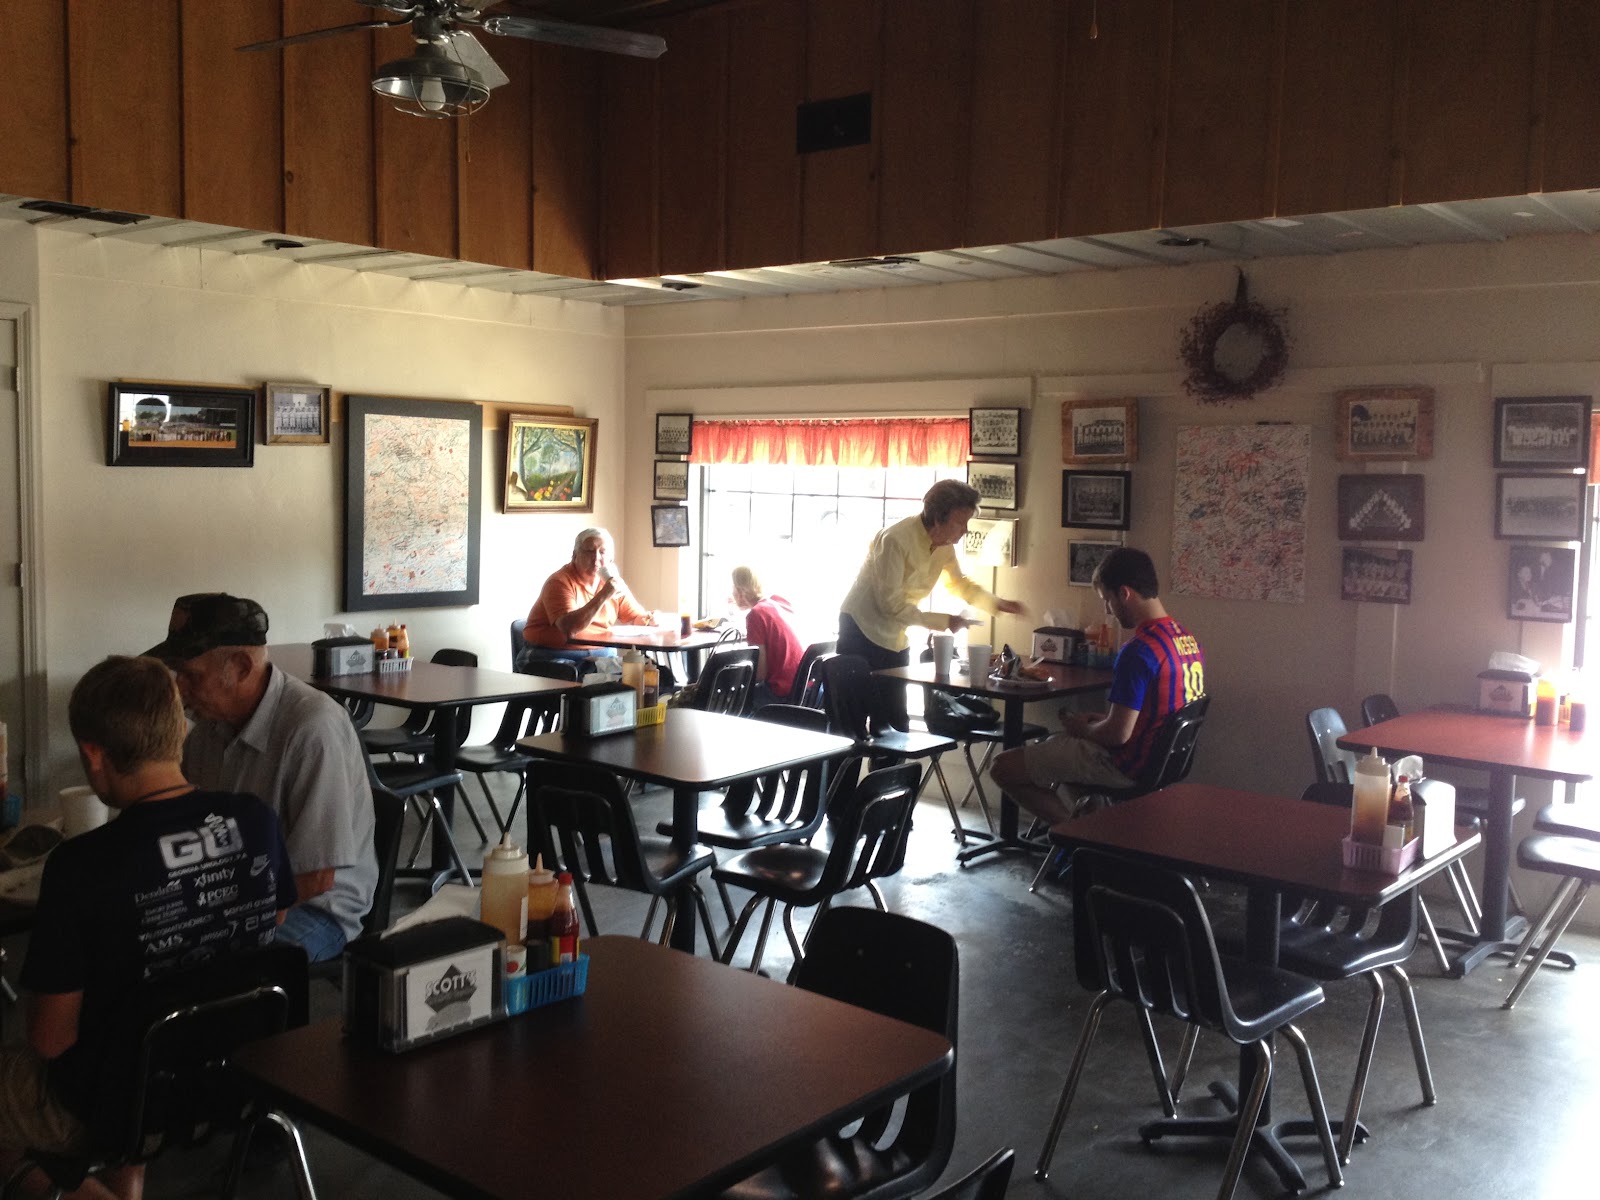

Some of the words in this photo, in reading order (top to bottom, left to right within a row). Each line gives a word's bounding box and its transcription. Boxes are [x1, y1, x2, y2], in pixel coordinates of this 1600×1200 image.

[1182, 661, 1204, 703] 10
[145, 933, 183, 952] AMS
[425, 970, 476, 997] SCOTT'S
